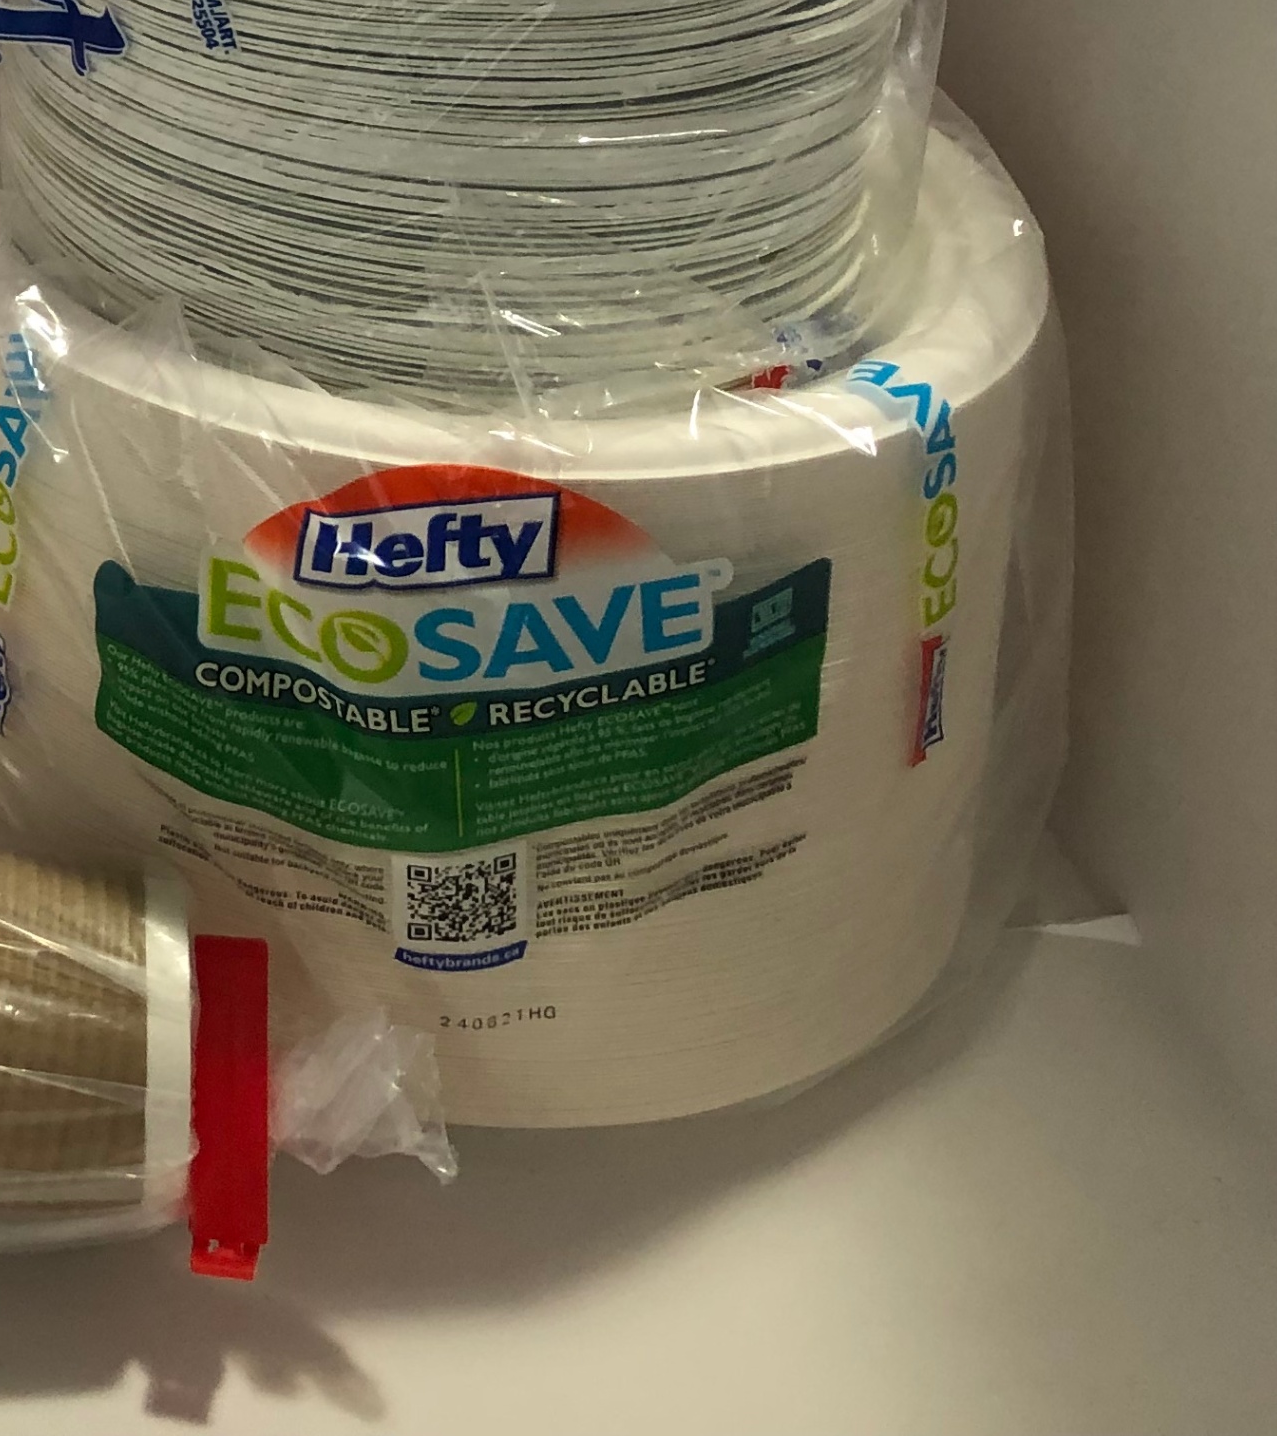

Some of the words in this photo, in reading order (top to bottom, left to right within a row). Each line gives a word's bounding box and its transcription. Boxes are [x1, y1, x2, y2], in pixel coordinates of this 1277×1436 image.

[311, 512, 544, 579] Hefty
[472, 740, 500, 751] Nos
[402, 760, 448, 773] reduce
[403, 948, 520, 969] heftybrands.ca
